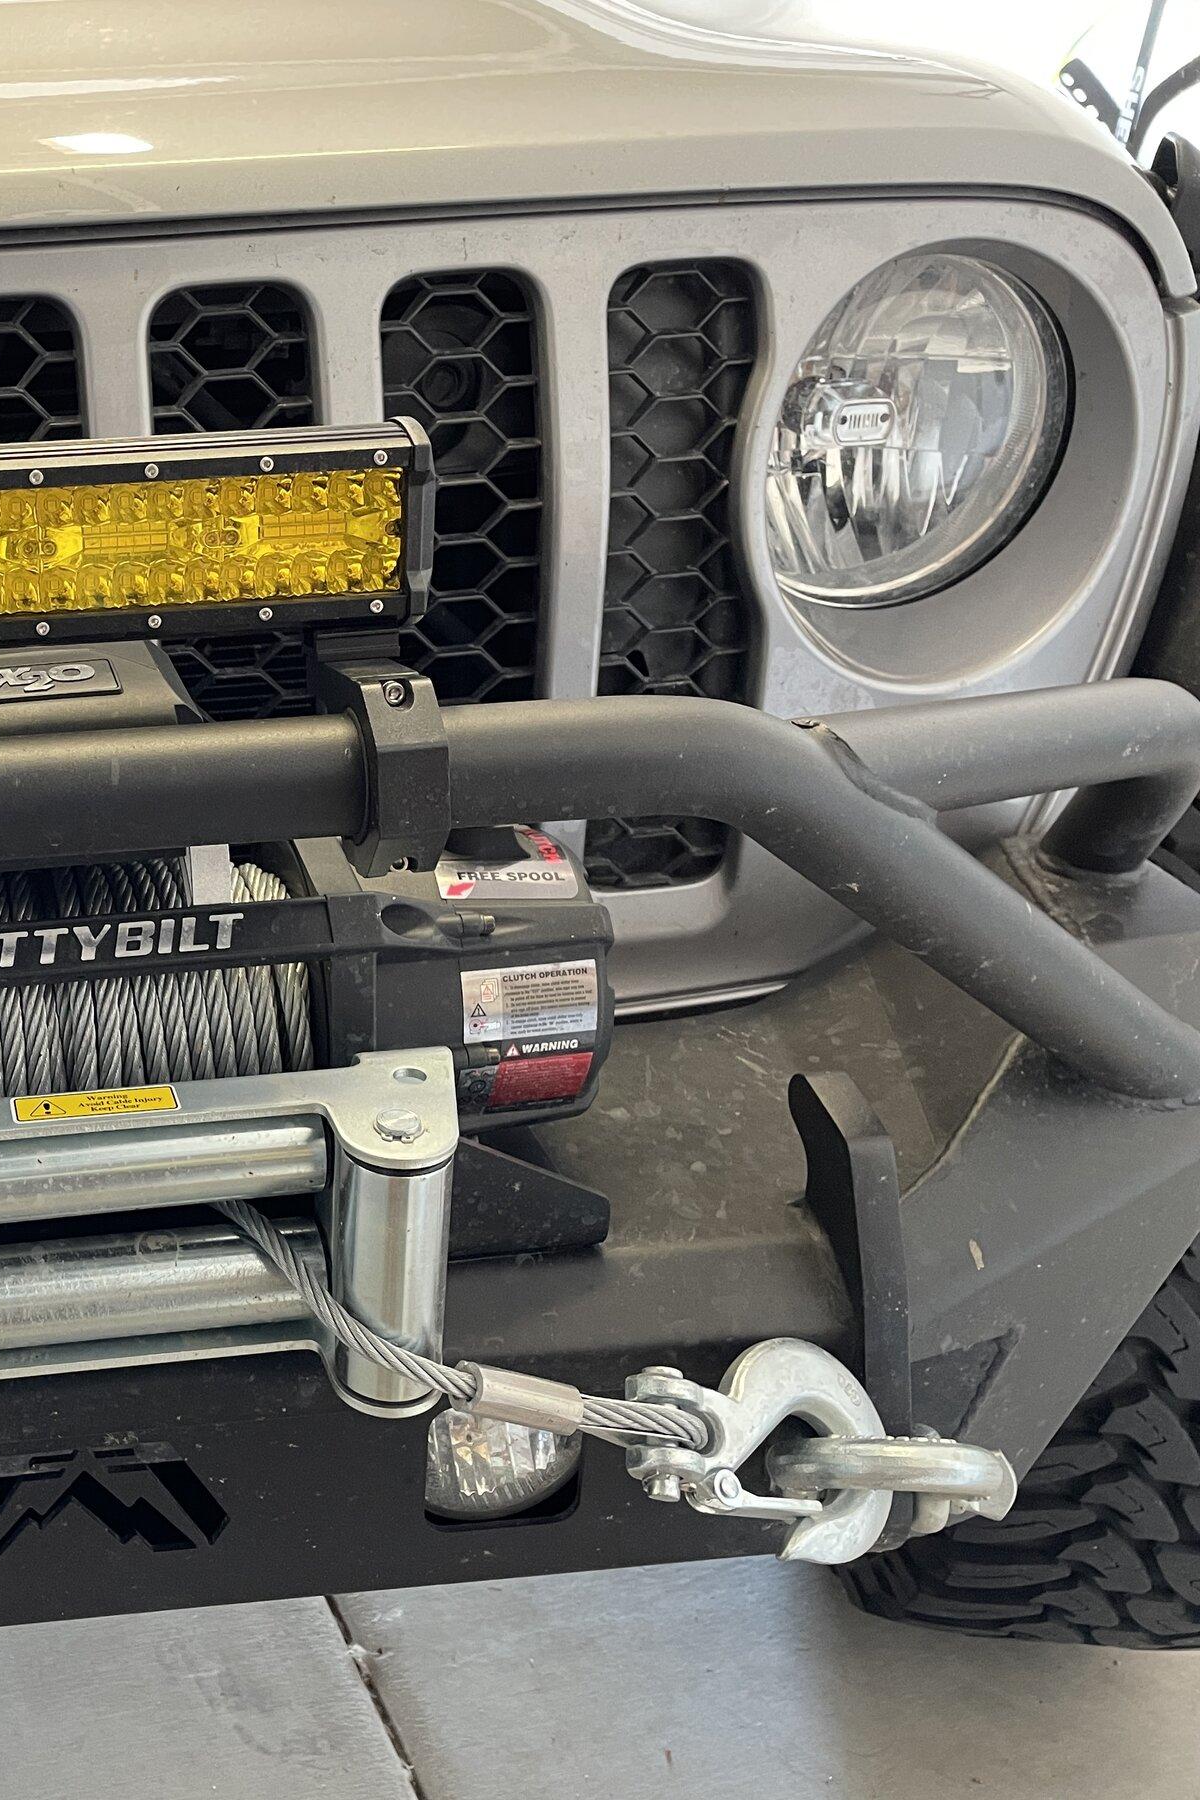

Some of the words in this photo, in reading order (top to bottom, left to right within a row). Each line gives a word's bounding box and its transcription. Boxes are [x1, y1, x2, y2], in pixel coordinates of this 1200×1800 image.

[456, 871, 500, 881] FREE
[506, 871, 565, 881] SPOOL
[502, 972, 537, 982] CLUTCH
[538, 967, 588, 979] OPERATION
[521, 1038, 579, 1054] WARNING
[86, 1093, 128, 1101] Warning
[134, 1096, 163, 1104] Injury
